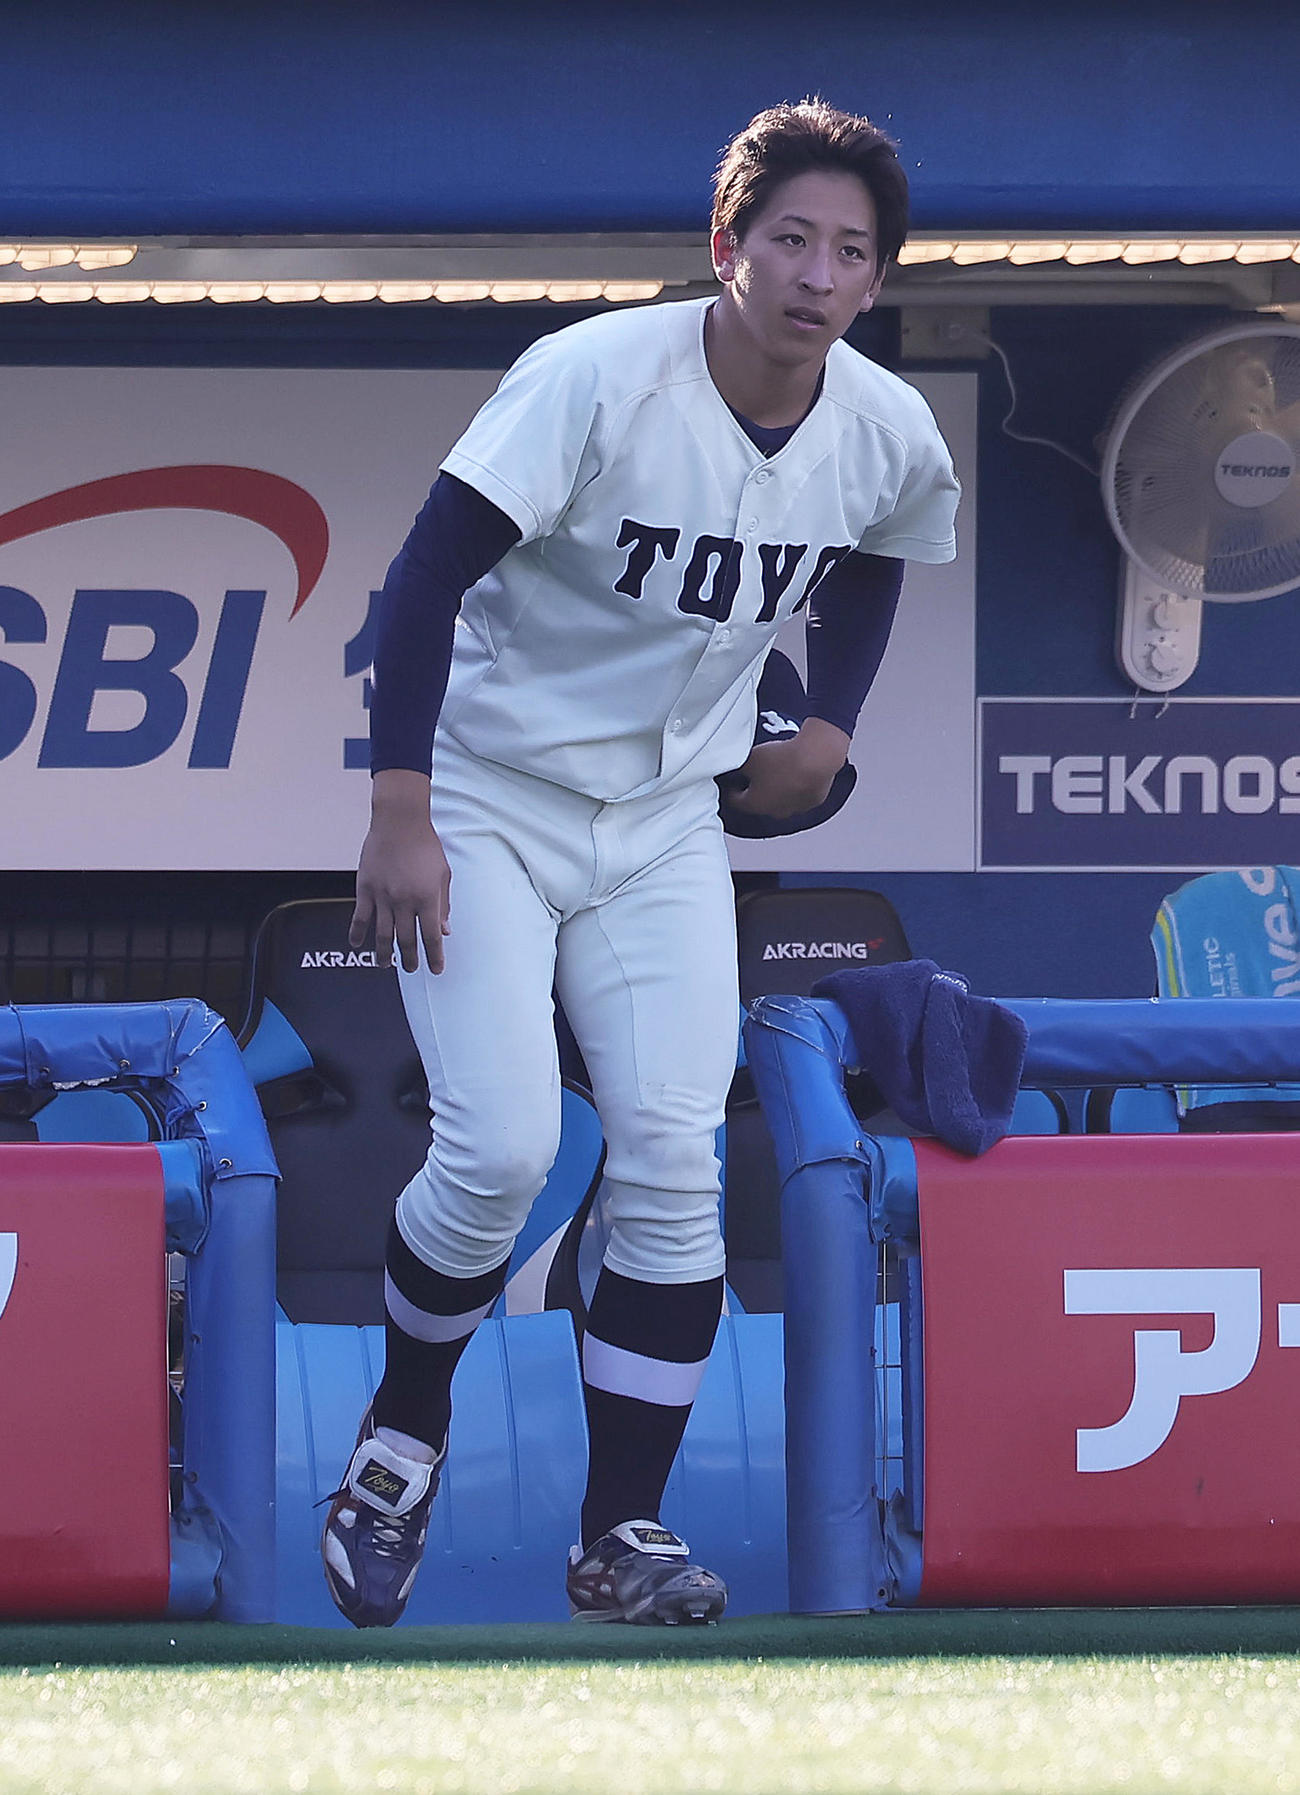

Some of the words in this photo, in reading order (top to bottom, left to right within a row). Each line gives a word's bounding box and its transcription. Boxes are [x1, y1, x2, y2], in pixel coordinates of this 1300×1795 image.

[1221, 464, 1291, 478] TEKNOS
[301, 951, 399, 968] AKRACI
[762, 942, 867, 960] AKRACING
[363, 1465, 400, 1494] Toyo
